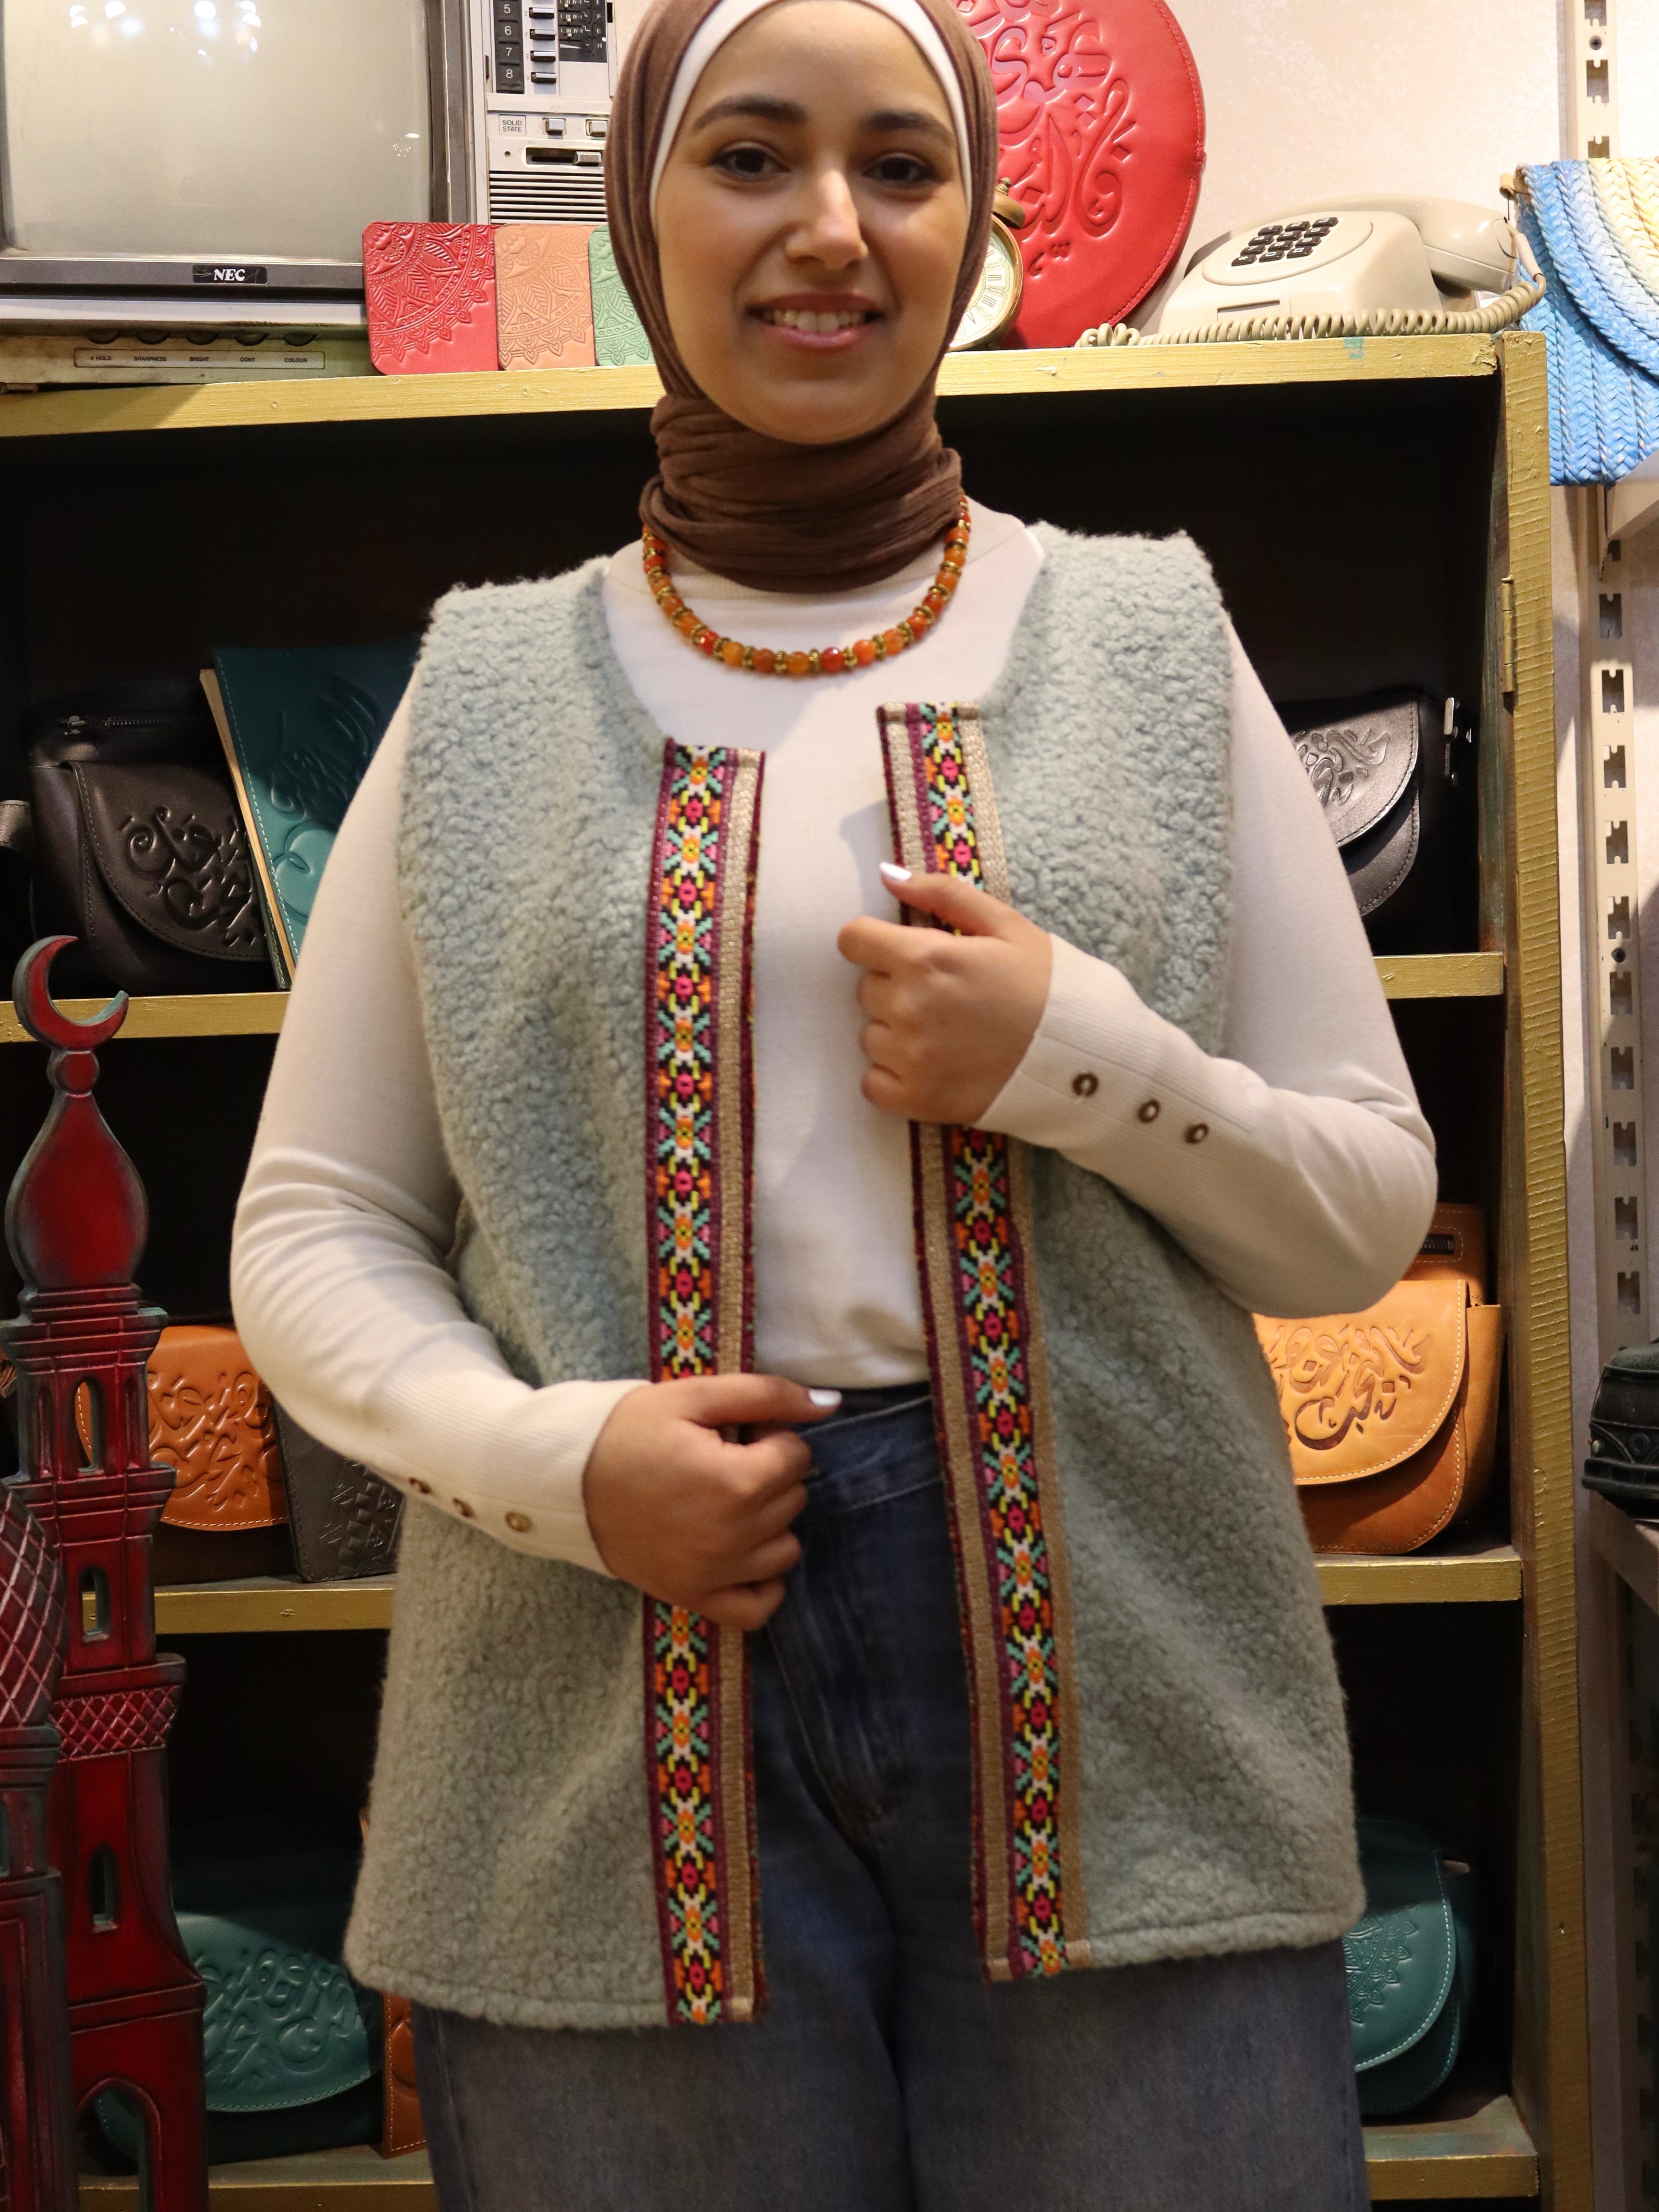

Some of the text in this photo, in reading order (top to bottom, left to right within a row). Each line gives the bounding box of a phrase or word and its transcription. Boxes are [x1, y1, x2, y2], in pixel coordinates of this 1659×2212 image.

[504, 4, 511, 13] 5
[505, 26, 512, 35] 6
[505, 47, 512, 57] 7
[506, 69, 513, 79] 8
[214, 268, 245, 281] NEC
